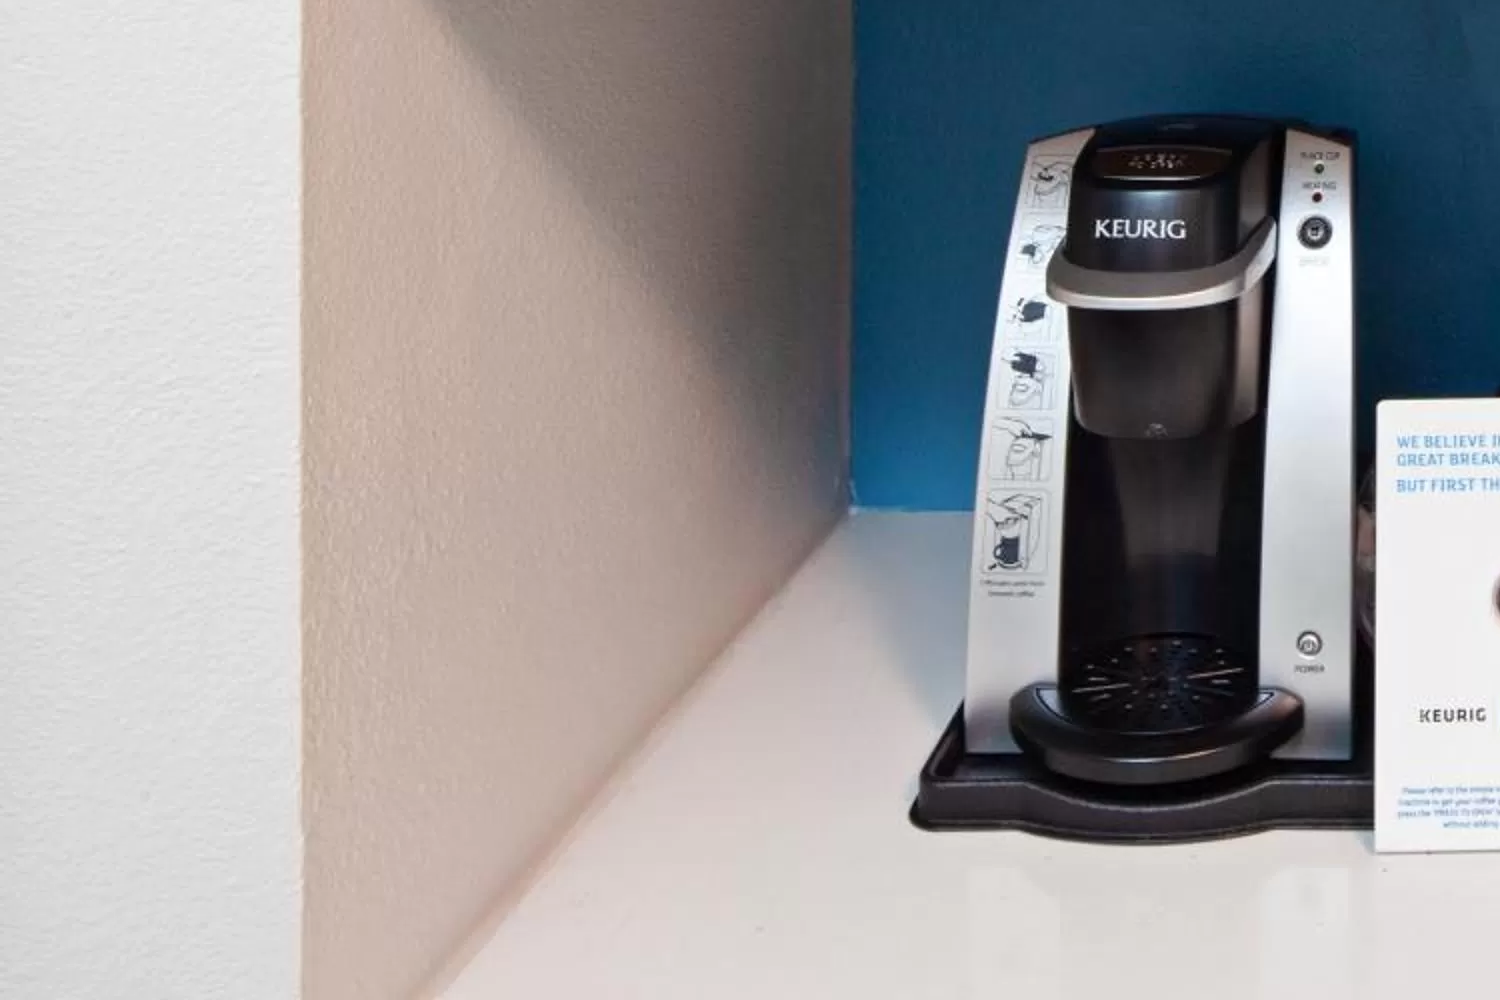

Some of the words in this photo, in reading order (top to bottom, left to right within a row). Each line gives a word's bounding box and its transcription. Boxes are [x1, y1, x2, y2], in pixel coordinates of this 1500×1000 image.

[1094, 218, 1187, 240] KEURIG
[1396, 434, 1419, 450] WE
[1423, 433, 1488, 449] BELIEVE
[1396, 452, 1445, 468] GREAT
[1396, 478, 1425, 494] BUT
[1430, 476, 1476, 493] FIRST
[1418, 707, 1487, 724] KEURIG
